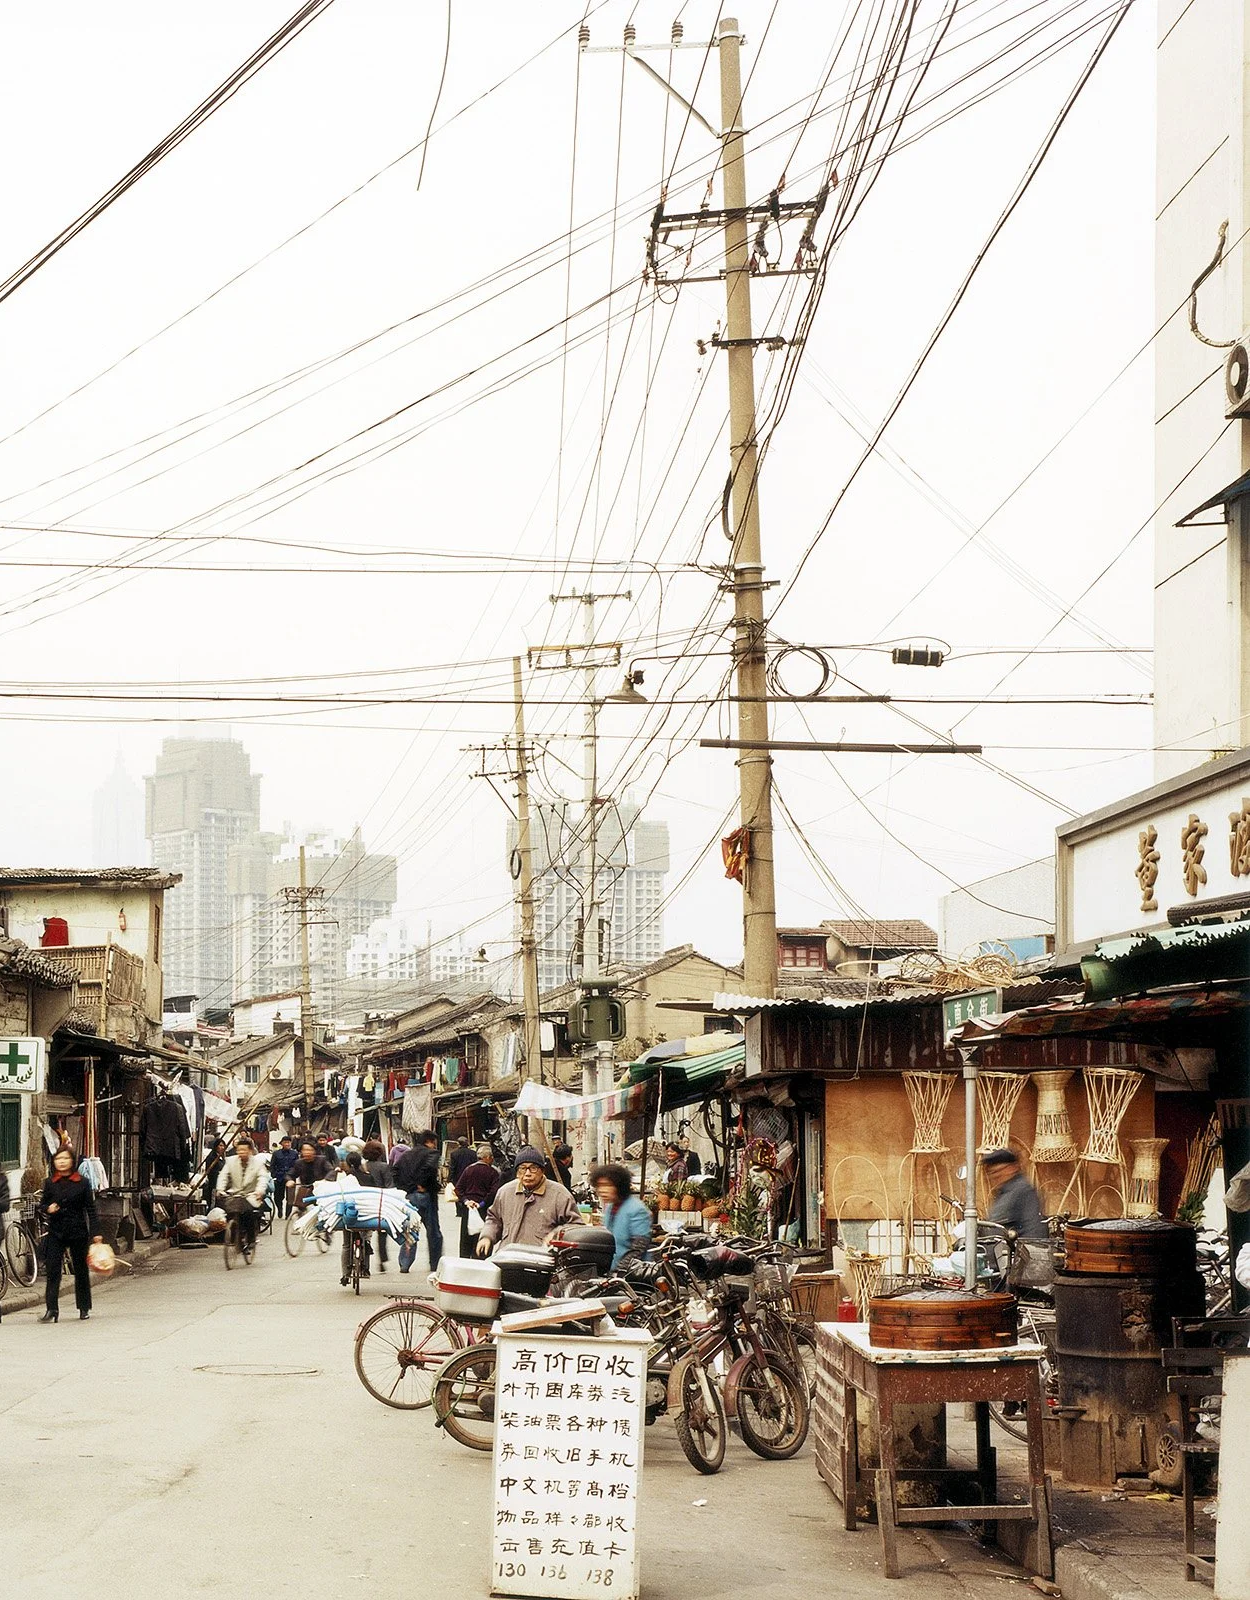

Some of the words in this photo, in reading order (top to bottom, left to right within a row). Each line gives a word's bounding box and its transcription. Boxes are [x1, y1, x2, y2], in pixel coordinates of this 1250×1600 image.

[512, 1348, 636, 1379] 高价回收
[500, 1411, 631, 1438] 柴油票各种债
[501, 1442, 635, 1468] 券回收旧手机
[500, 1476, 630, 1500] 中文机等高档
[499, 1563, 526, 1578] 130
[586, 1569, 614, 1586] 138
